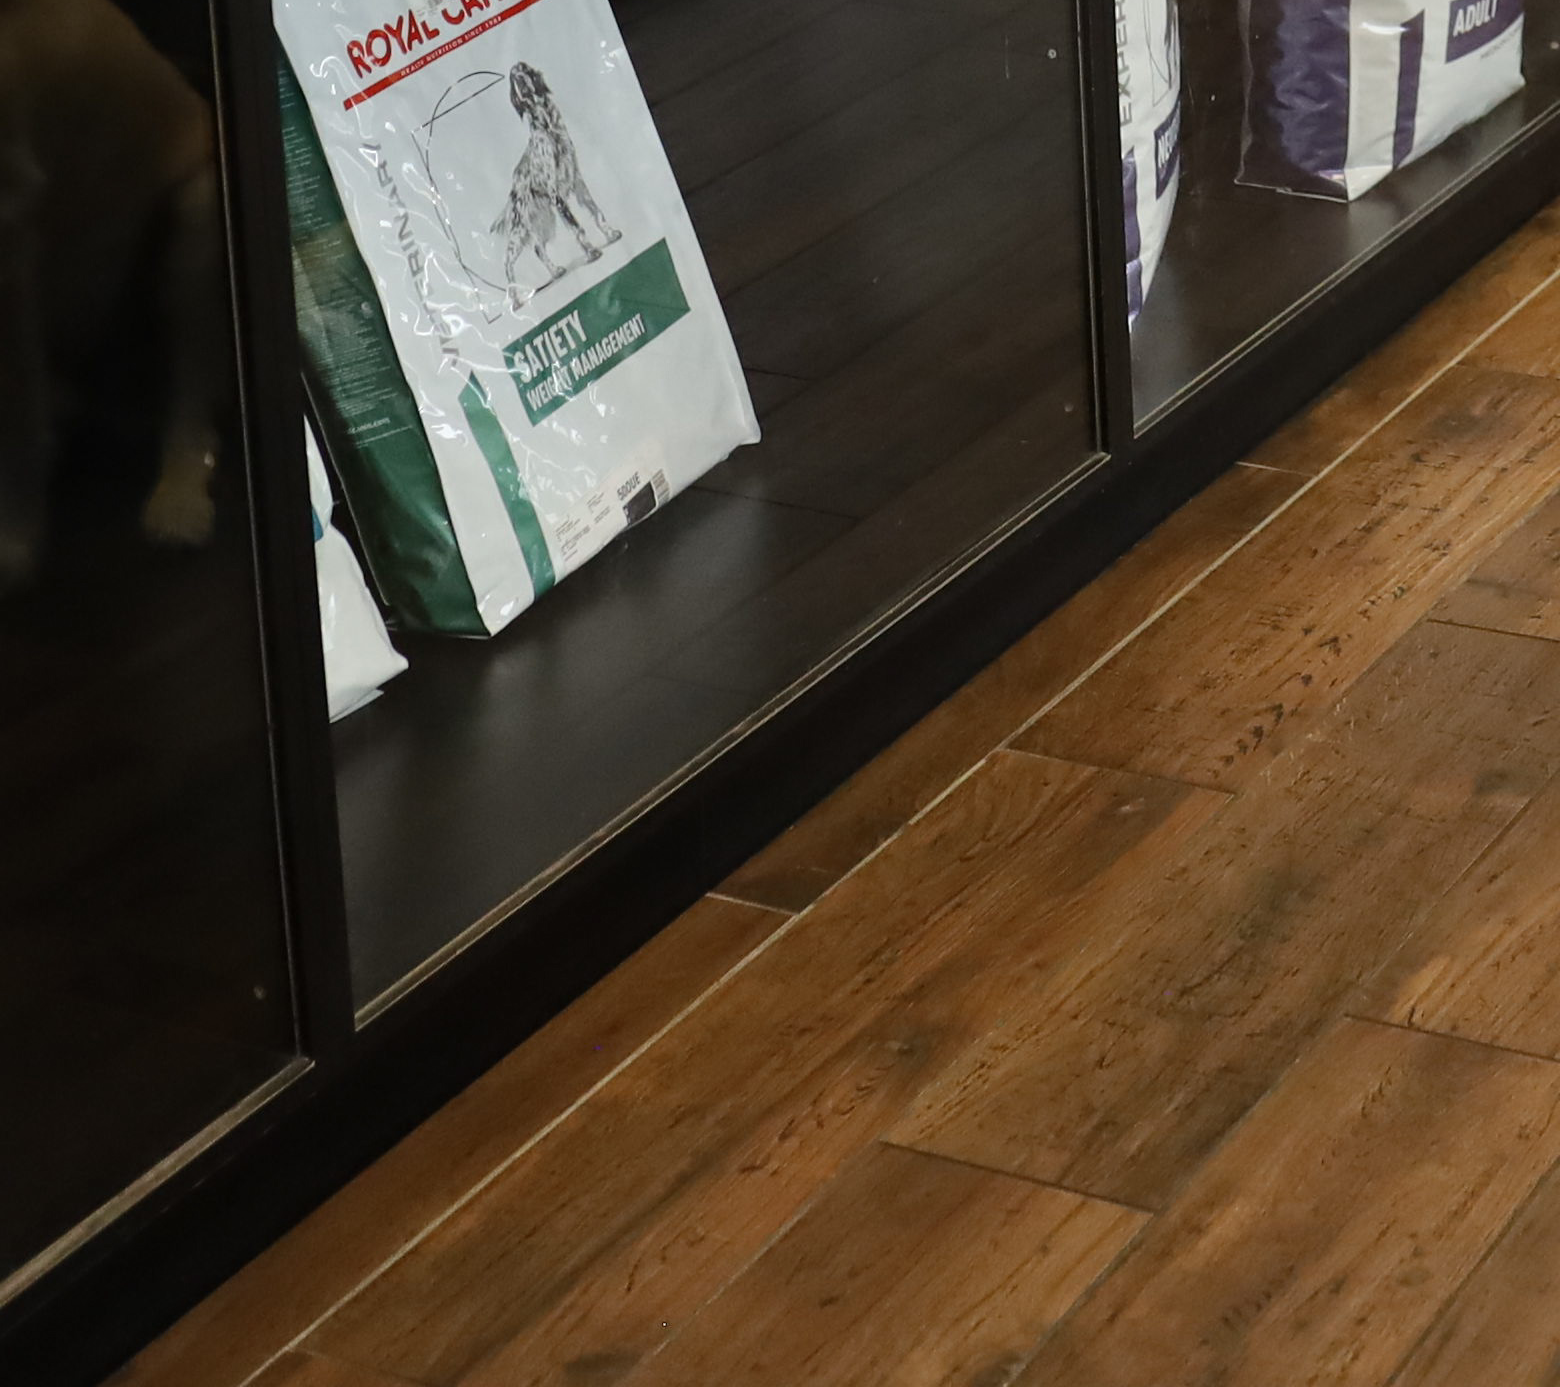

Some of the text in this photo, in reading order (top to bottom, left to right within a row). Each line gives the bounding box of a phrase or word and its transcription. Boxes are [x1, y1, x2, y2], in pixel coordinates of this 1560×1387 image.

[345, 8, 441, 79] ROYAL
[513, 308, 589, 385] SATIETY
[526, 312, 647, 412] WEIGHT MANAGEMENT
